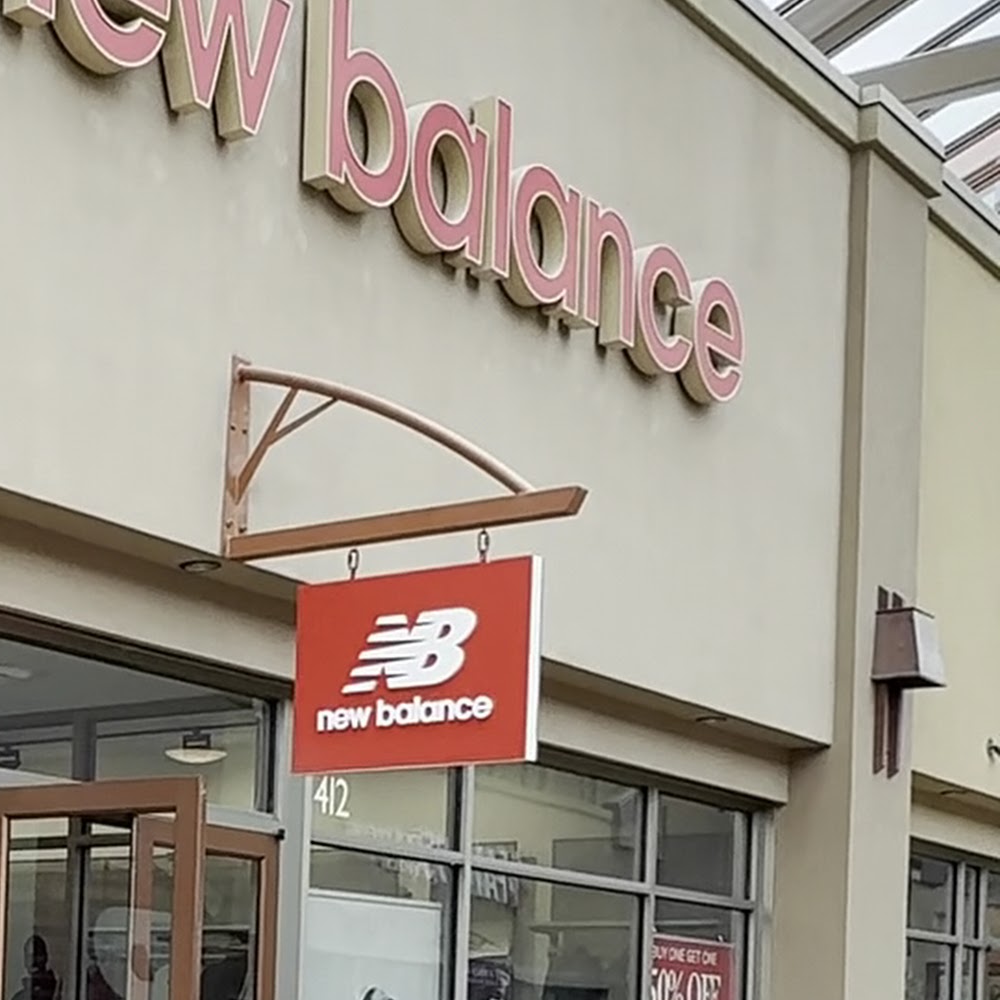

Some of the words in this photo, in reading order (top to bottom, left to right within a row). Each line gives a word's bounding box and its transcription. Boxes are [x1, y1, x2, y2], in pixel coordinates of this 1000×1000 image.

[304, 0, 744, 403] balance
[316, 704, 373, 732] new
[375, 695, 494, 727] balance
[314, 776, 350, 818] 412
